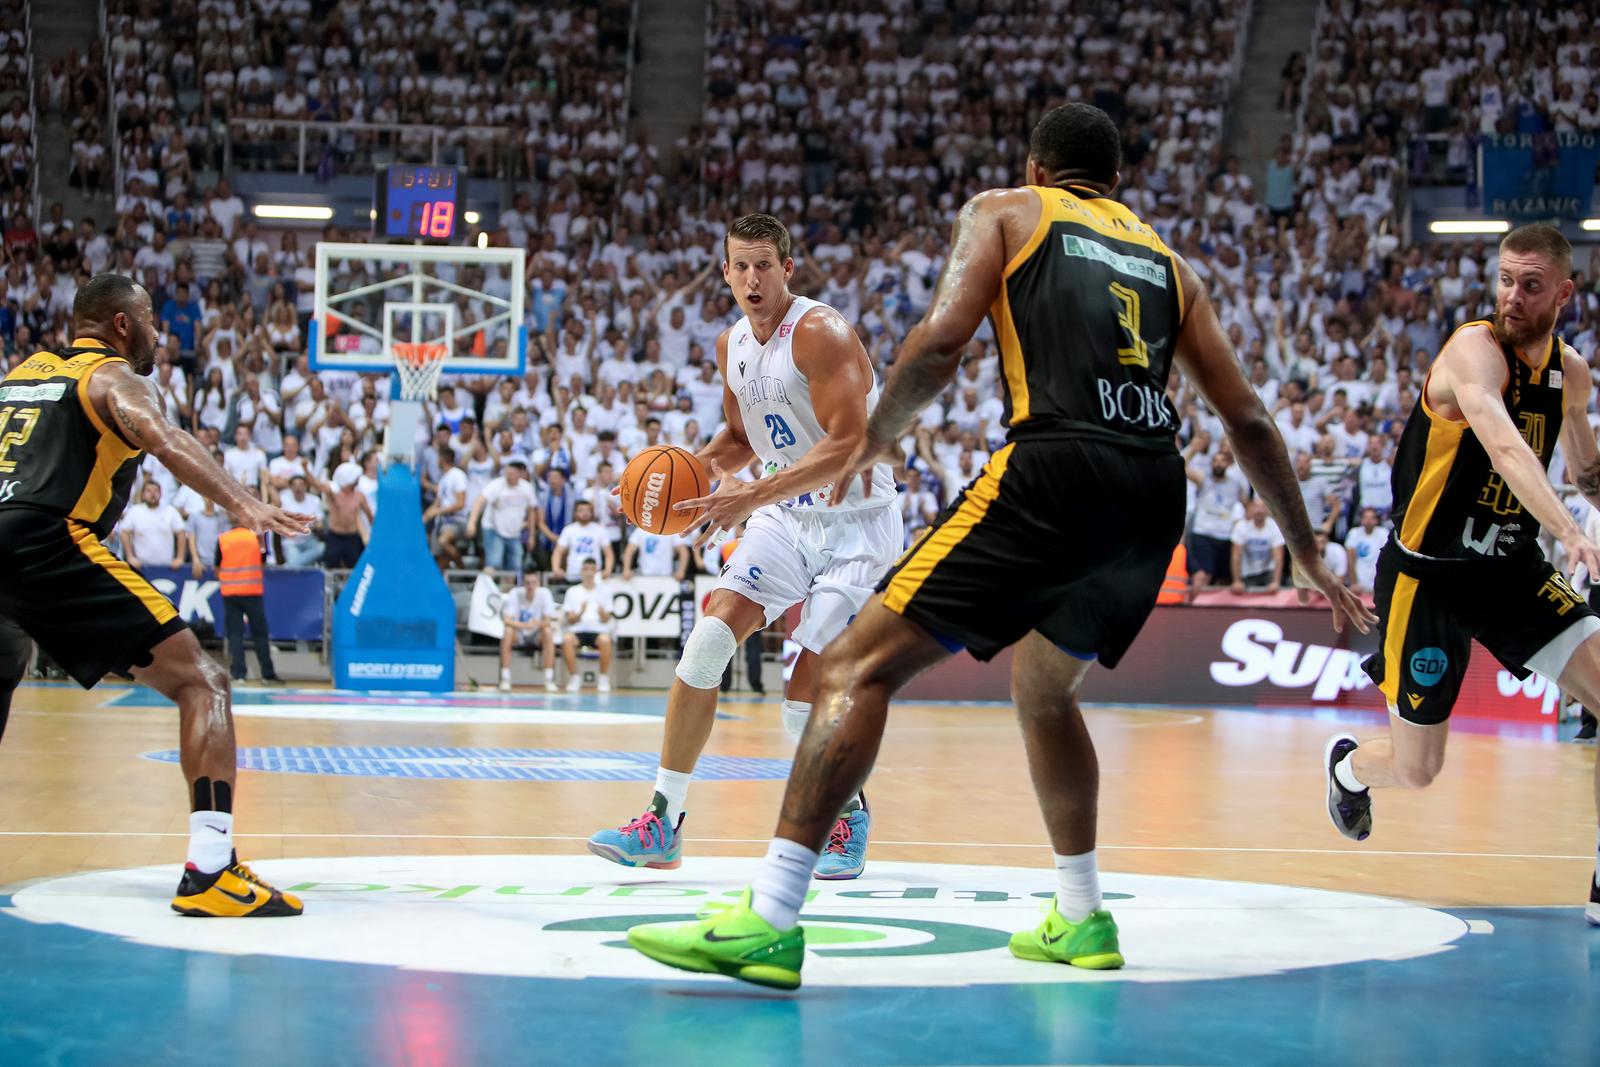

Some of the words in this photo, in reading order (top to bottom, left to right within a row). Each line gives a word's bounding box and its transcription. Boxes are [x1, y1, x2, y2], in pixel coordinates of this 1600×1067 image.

[1490, 132, 1595, 149] TORADO
[419, 202, 455, 238] 18
[1108, 281, 1149, 369] 3
[764, 413, 797, 450] 29
[641, 472, 667, 528] Wilson
[1412, 657, 1446, 675] GDi
